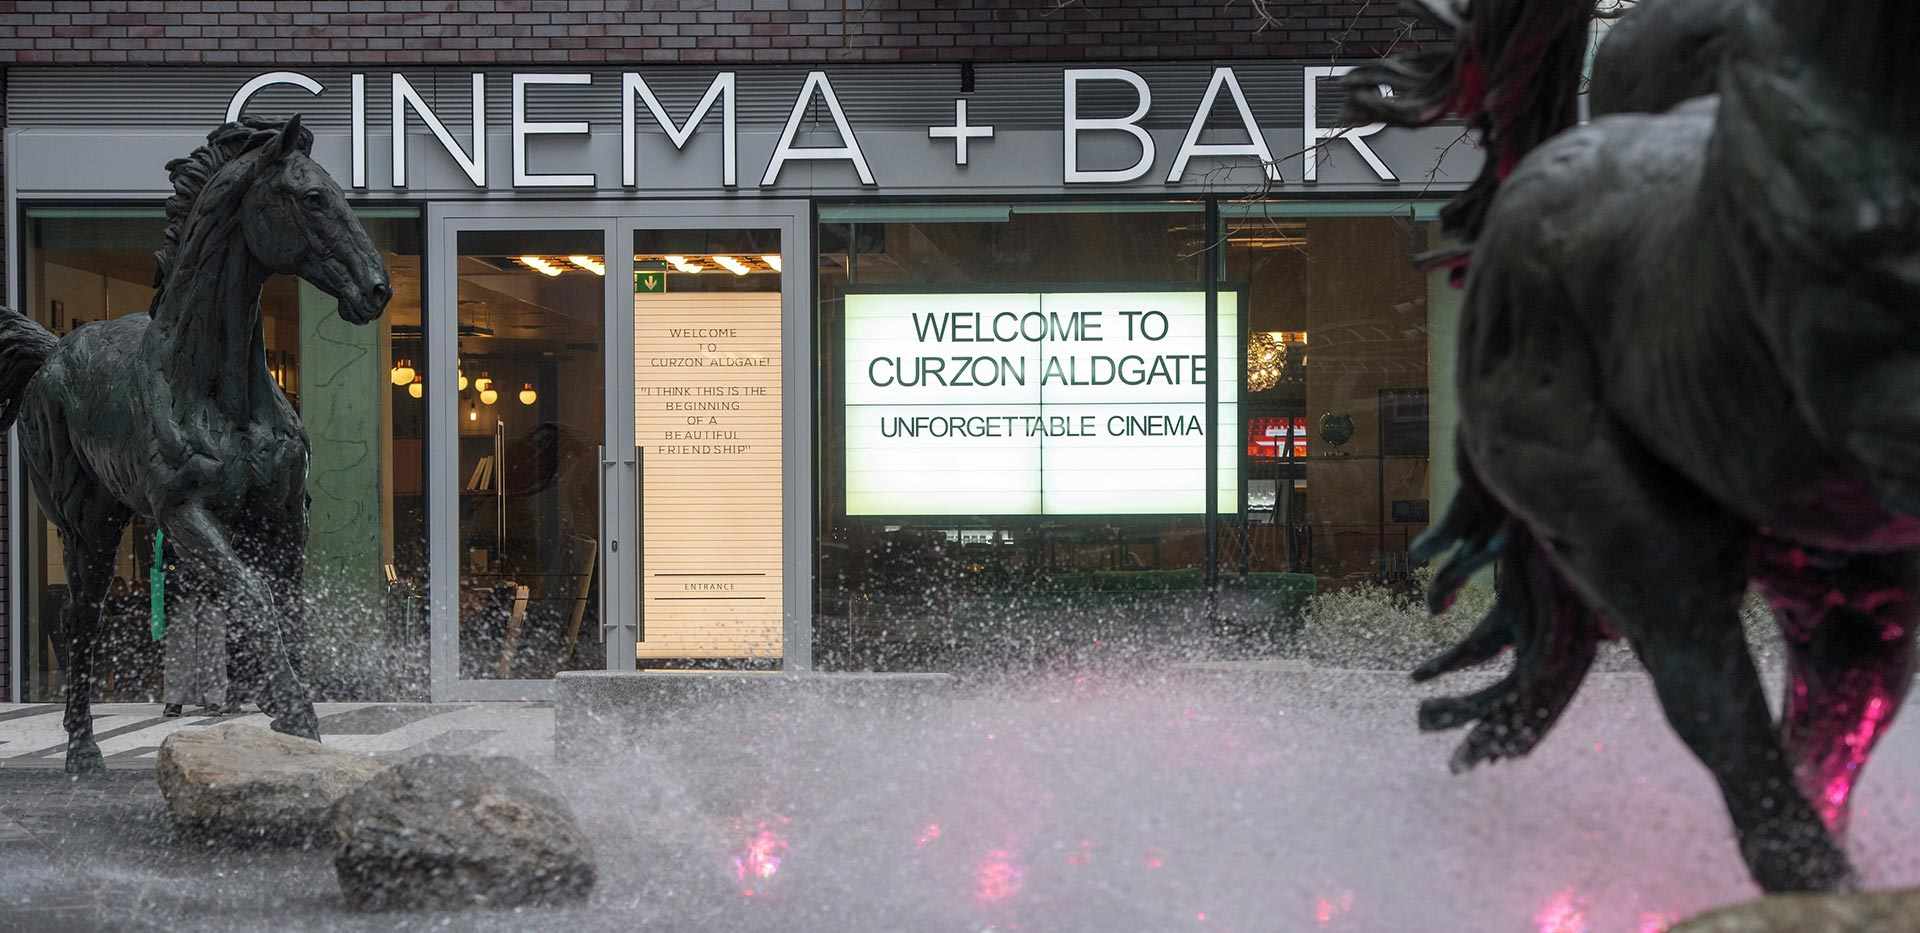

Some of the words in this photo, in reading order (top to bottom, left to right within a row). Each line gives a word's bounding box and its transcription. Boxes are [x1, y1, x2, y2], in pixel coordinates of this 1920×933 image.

[1063, 66, 1400, 184] BAR
[912, 311, 1103, 343] WELCOME
[1118, 310, 1169, 341] TO
[669, 328, 737, 338] WELCOME
[699, 343, 717, 352] TO
[651, 358, 703, 367] CURZON
[710, 357, 771, 367] ALDGATE!
[868, 356, 1025, 387] CURZON
[1041, 355, 1206, 386] ALDGATE
[656, 387, 691, 396] THINK
[697, 387, 724, 396] THIS
[727, 387, 739, 396] IS
[744, 387, 767, 396] THE
[666, 402, 740, 411] BEGINNING
[687, 416, 703, 425] OF
[708, 416, 718, 425] A
[881, 416, 1096, 438] UNFORGETTABLE
[1107, 415, 1203, 437] CINEMA
[665, 431, 739, 440] BEAUTIFUL
[658, 445, 751, 455] FRIENDSHIP"
